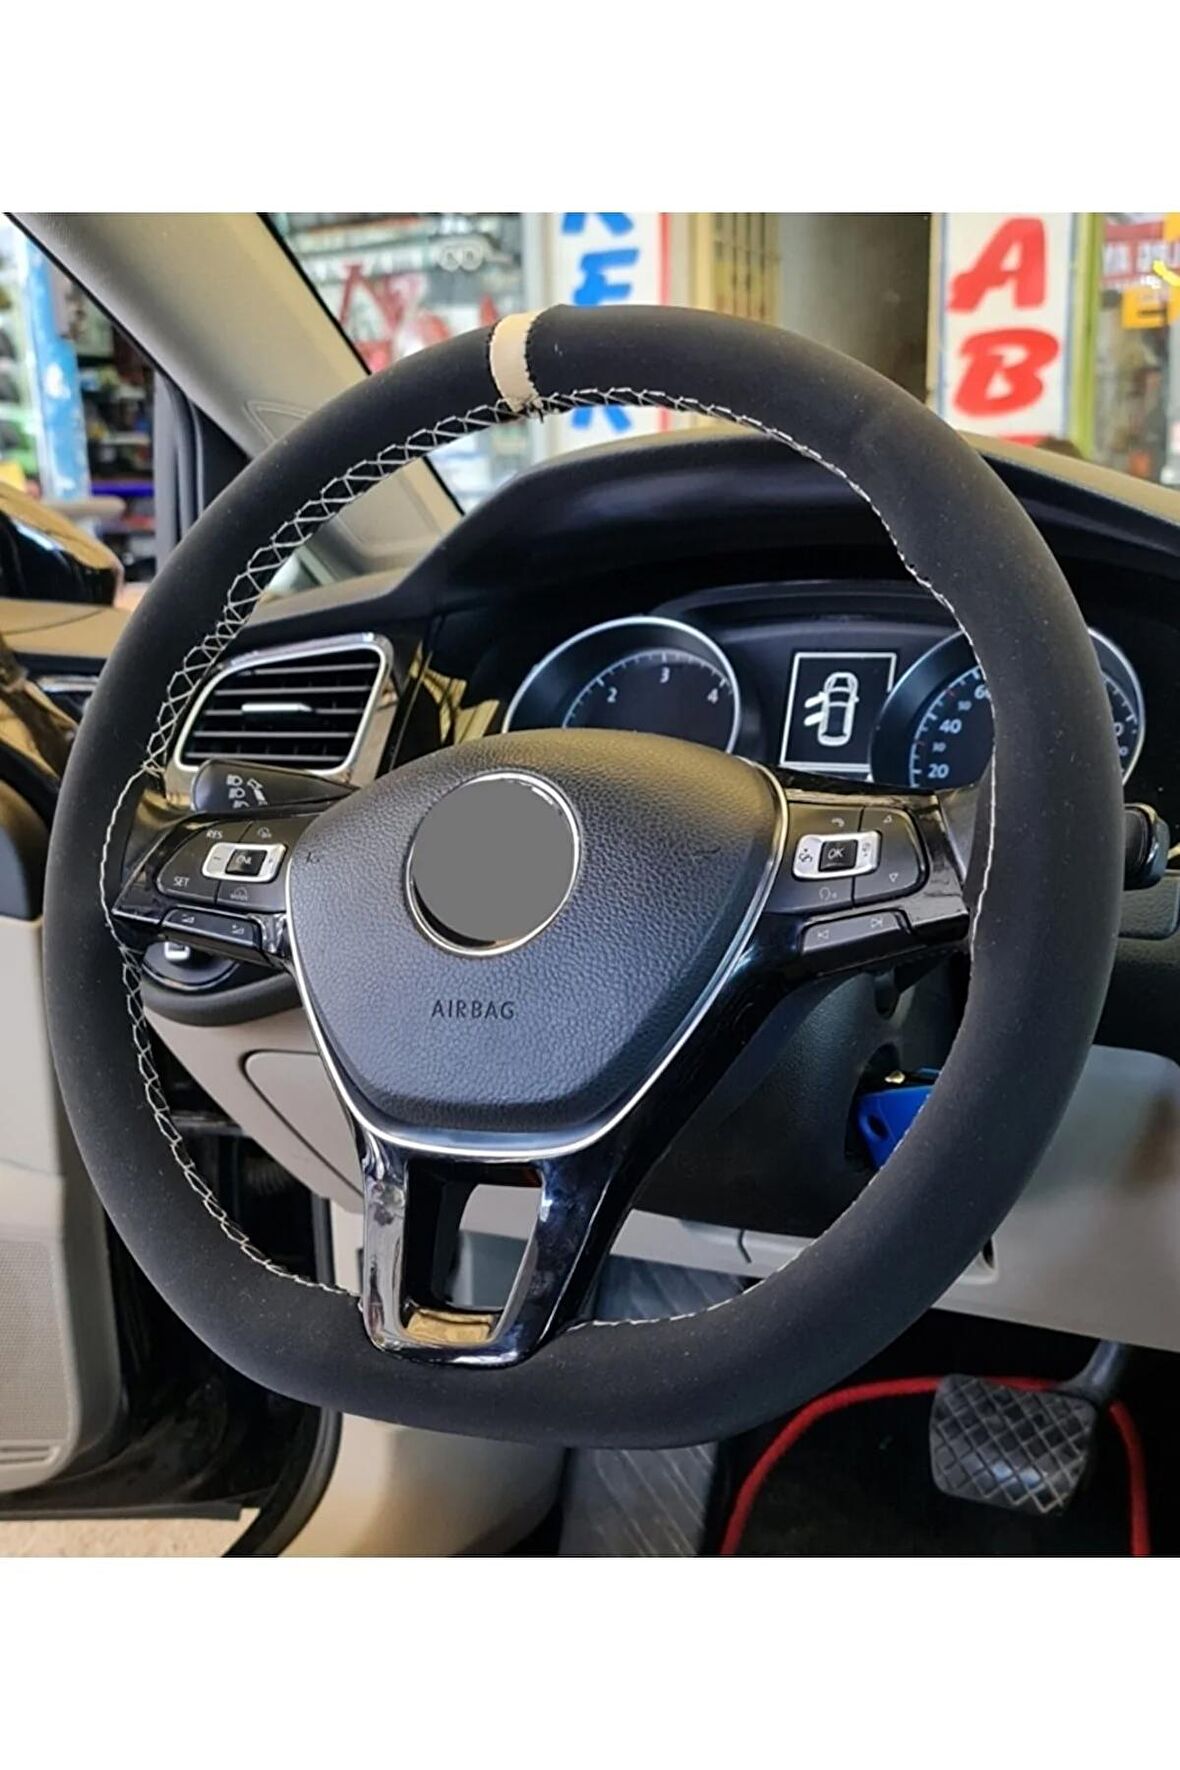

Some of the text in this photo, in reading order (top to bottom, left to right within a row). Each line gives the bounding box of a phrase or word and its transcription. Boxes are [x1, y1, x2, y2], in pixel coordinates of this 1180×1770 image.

[660, 667, 670, 684] 3
[607, 687, 618, 703] 2
[707, 688, 719, 704] 4
[939, 718, 962, 734] 40
[928, 763, 950, 779] 20
[828, 847, 846, 860] OK
[174, 876, 190, 888] SET
[431, 1000, 516, 1020] AIRBAG
